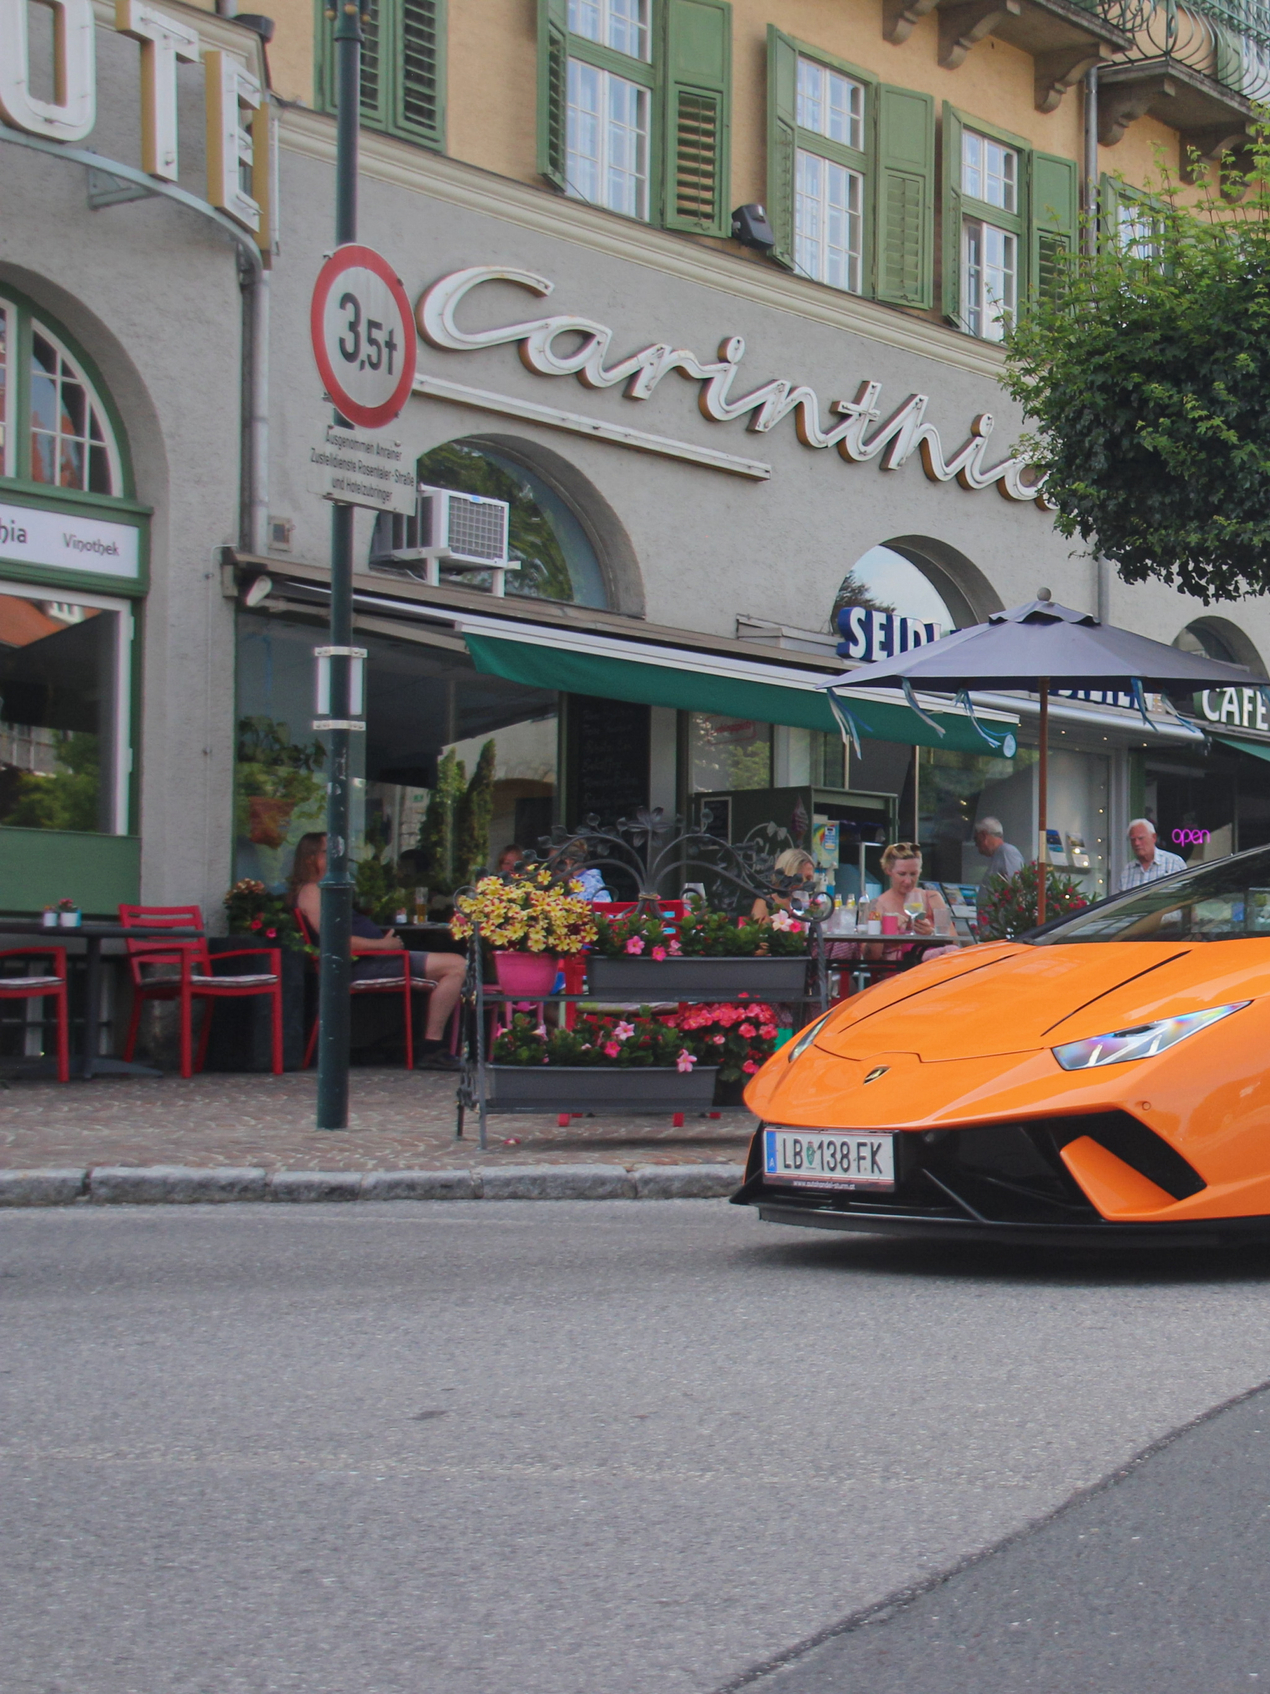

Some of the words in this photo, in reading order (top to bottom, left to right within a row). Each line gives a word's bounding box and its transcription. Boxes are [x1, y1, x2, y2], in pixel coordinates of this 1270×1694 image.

[0, 0, 279, 262] OTE
[339, 292, 397, 376] 3,5t
[416, 265, 1061, 511] Carinthia
[311, 448, 356, 472] Zustelldienste
[326, 432, 374, 454] Ausgenommen
[376, 442, 402, 461] Anrainer
[332, 477, 345, 490] und
[346, 478, 393, 504] Hotelzubringer
[63, 533, 119, 556] Vinothek
[1172, 828, 1211, 847] open
[783, 1137, 803, 1169] LB
